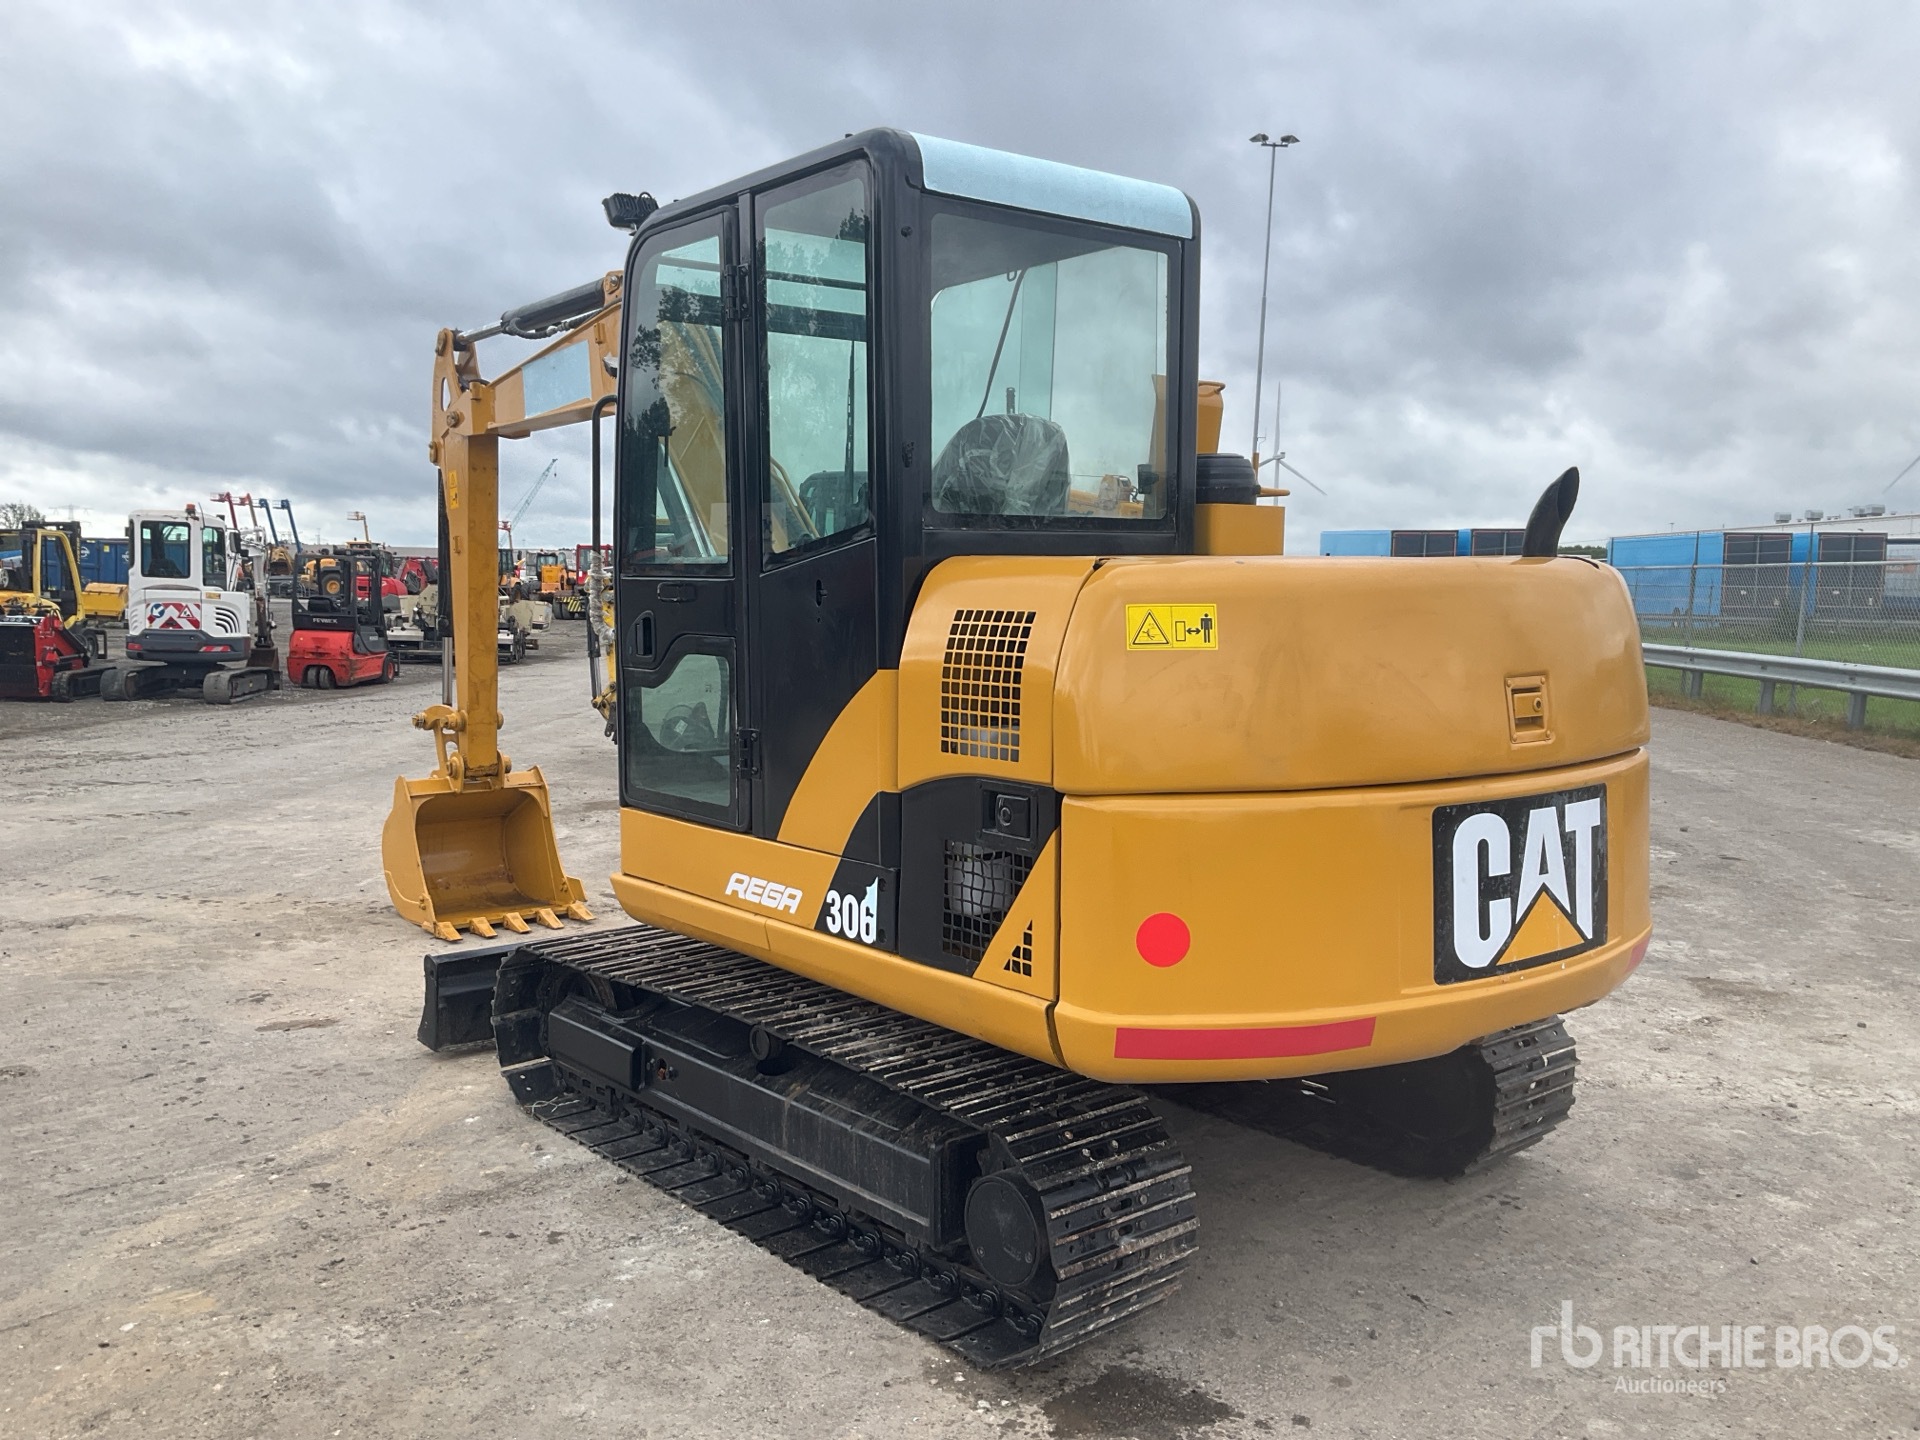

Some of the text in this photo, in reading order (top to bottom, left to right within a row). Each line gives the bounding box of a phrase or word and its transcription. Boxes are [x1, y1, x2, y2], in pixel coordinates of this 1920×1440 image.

[725, 872, 803, 914] REGA
[1453, 797, 1601, 969] CAT
[826, 889, 877, 944] 306
